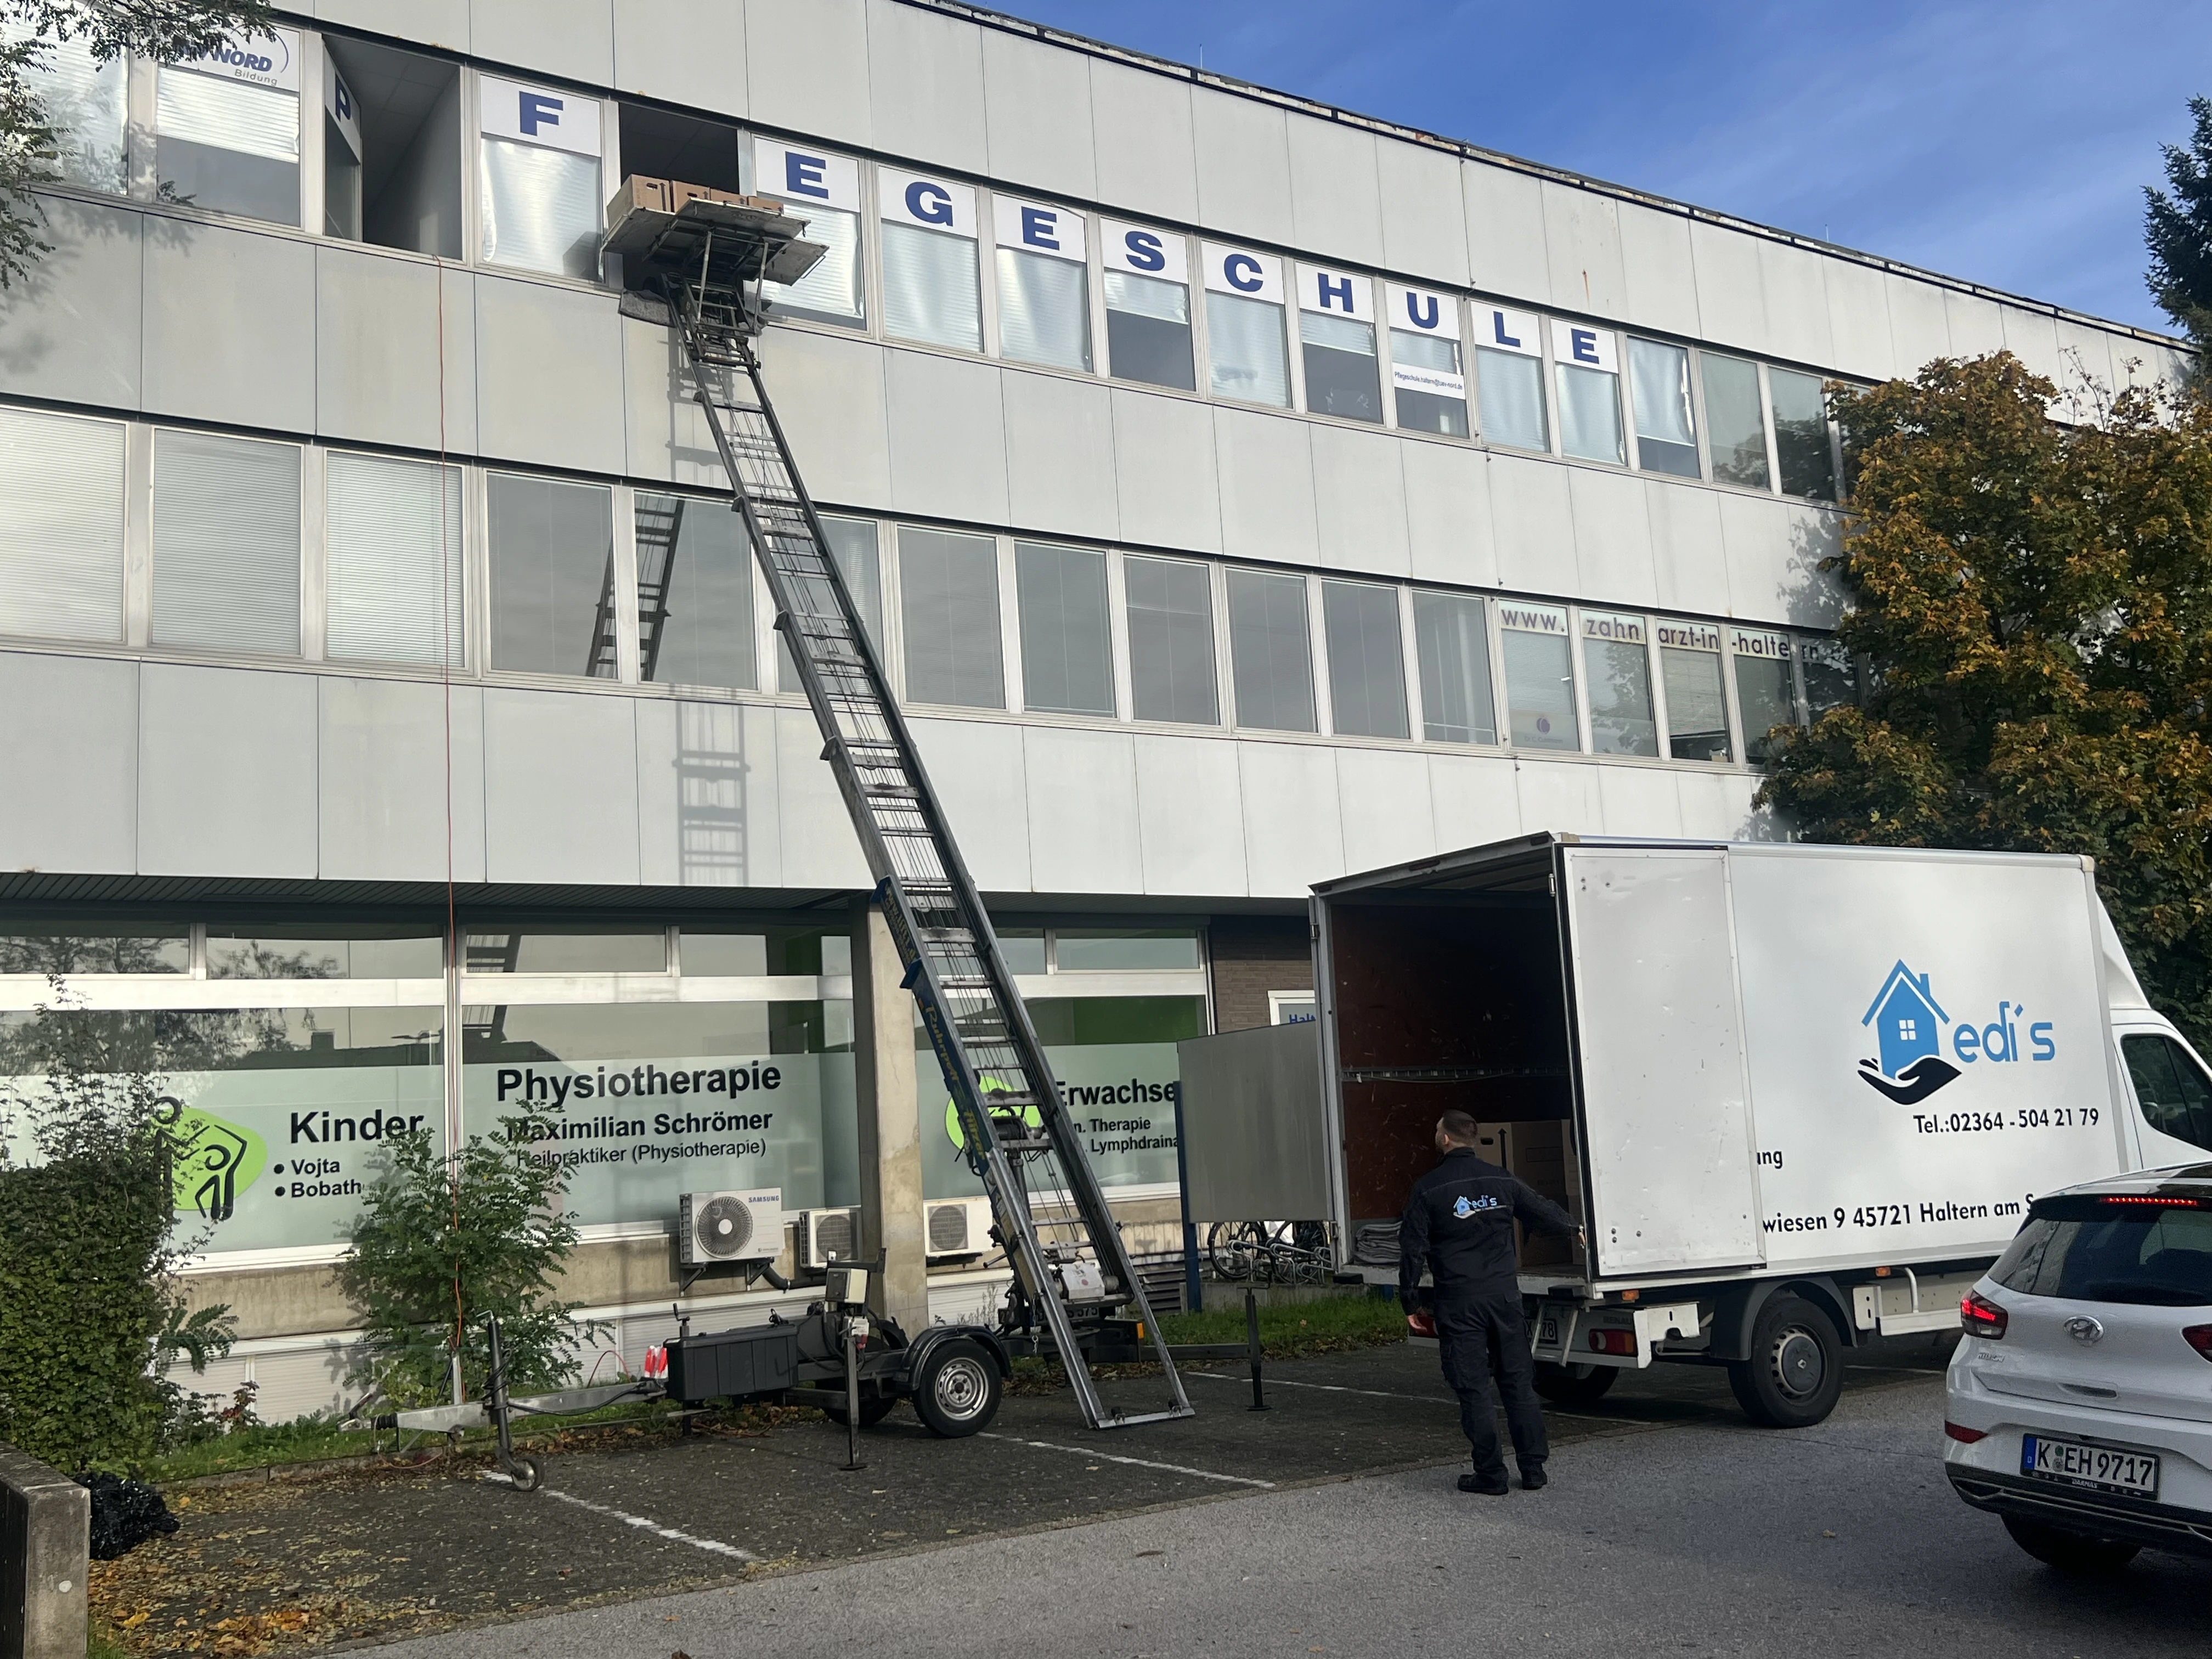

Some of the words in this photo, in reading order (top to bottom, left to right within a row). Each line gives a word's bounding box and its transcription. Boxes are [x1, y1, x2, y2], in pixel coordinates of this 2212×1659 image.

[213, 48, 273, 72] NORD
[234, 69, 278, 87] Bildung
[335, 71, 351, 122] P
[518, 91, 563, 137] F
[785, 151, 829, 200] E
[905, 181, 953, 227] G
[1020, 206, 1060, 251] E
[1125, 230, 1165, 272] S
[1223, 253, 1263, 292] C
[1317, 273, 1354, 313] H
[1406, 291, 1439, 330] U
[1493, 311, 1521, 347] L
[1571, 328, 1600, 364] E
[1501, 609, 1565, 633] www.
[1586, 617, 1640, 641] zahn
[1658, 627, 1719, 650] arzt-in
[498, 1060, 781, 1108] Physiotherapie
[291, 1109, 425, 1144] Kinder
[654, 1111, 773, 1135] Schrömer
[1089, 1116, 1151, 1133] Therapie
[1913, 1111, 2004, 1134] Tel.:02364
[2054, 1108, 2073, 1126] 21
[2079, 1108, 2099, 1126] 79
[632, 1137, 766, 1165] (Physiotherapie)
[291, 1158, 341, 1178] Vojta
[291, 1179, 362, 1198] Bobath
[1762, 1212, 1827, 1233] wiesen
[1833, 1207, 1846, 1228] 9
[1853, 1204, 1911, 1227] 45721
[1919, 1200, 1988, 1223] Haltern
[1994, 1201, 2021, 1216] am
[2037, 1442, 2051, 1468] K
[2064, 1447, 2093, 1476] EH
[2097, 1453, 2153, 1486] 9717
